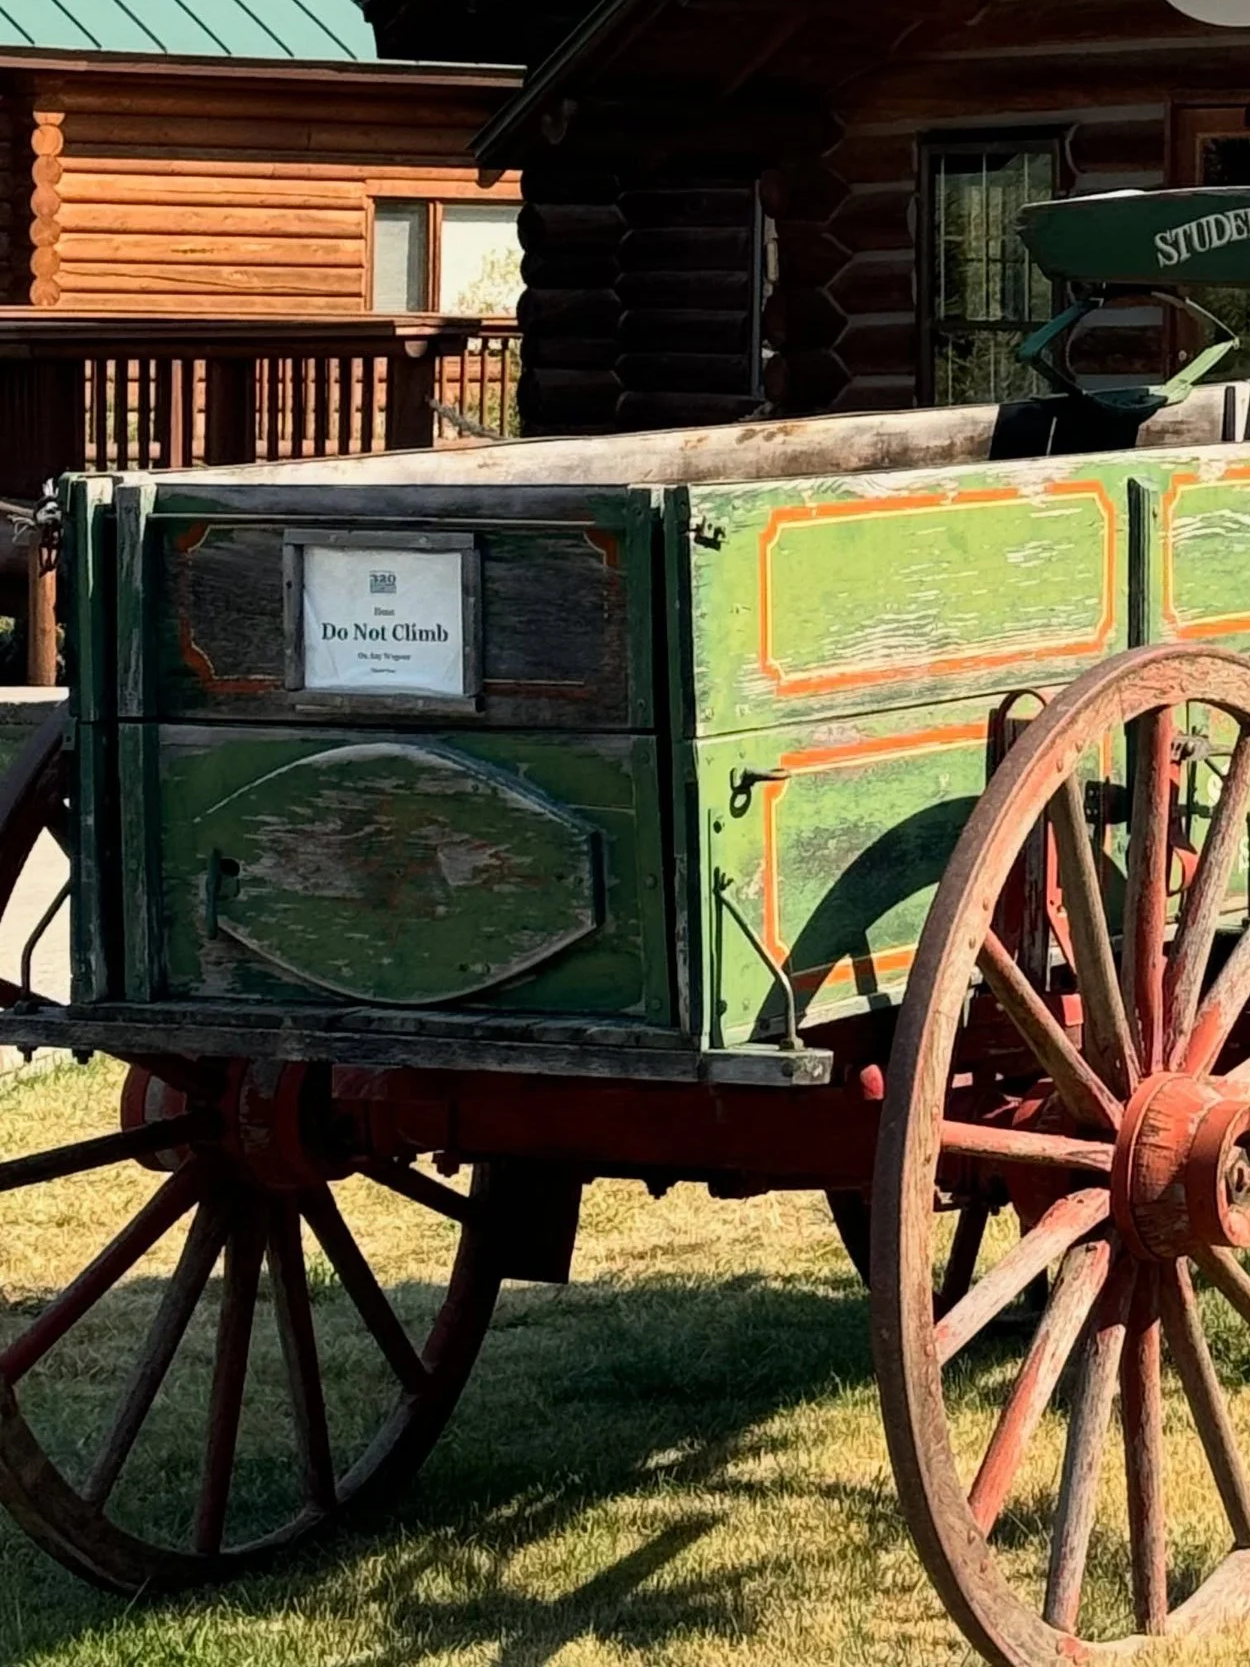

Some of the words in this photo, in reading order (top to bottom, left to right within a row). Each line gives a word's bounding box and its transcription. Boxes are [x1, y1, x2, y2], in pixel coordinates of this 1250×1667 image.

[321, 622, 349, 641] Do
[353, 622, 388, 642] Not
[392, 622, 449, 643] Climb
